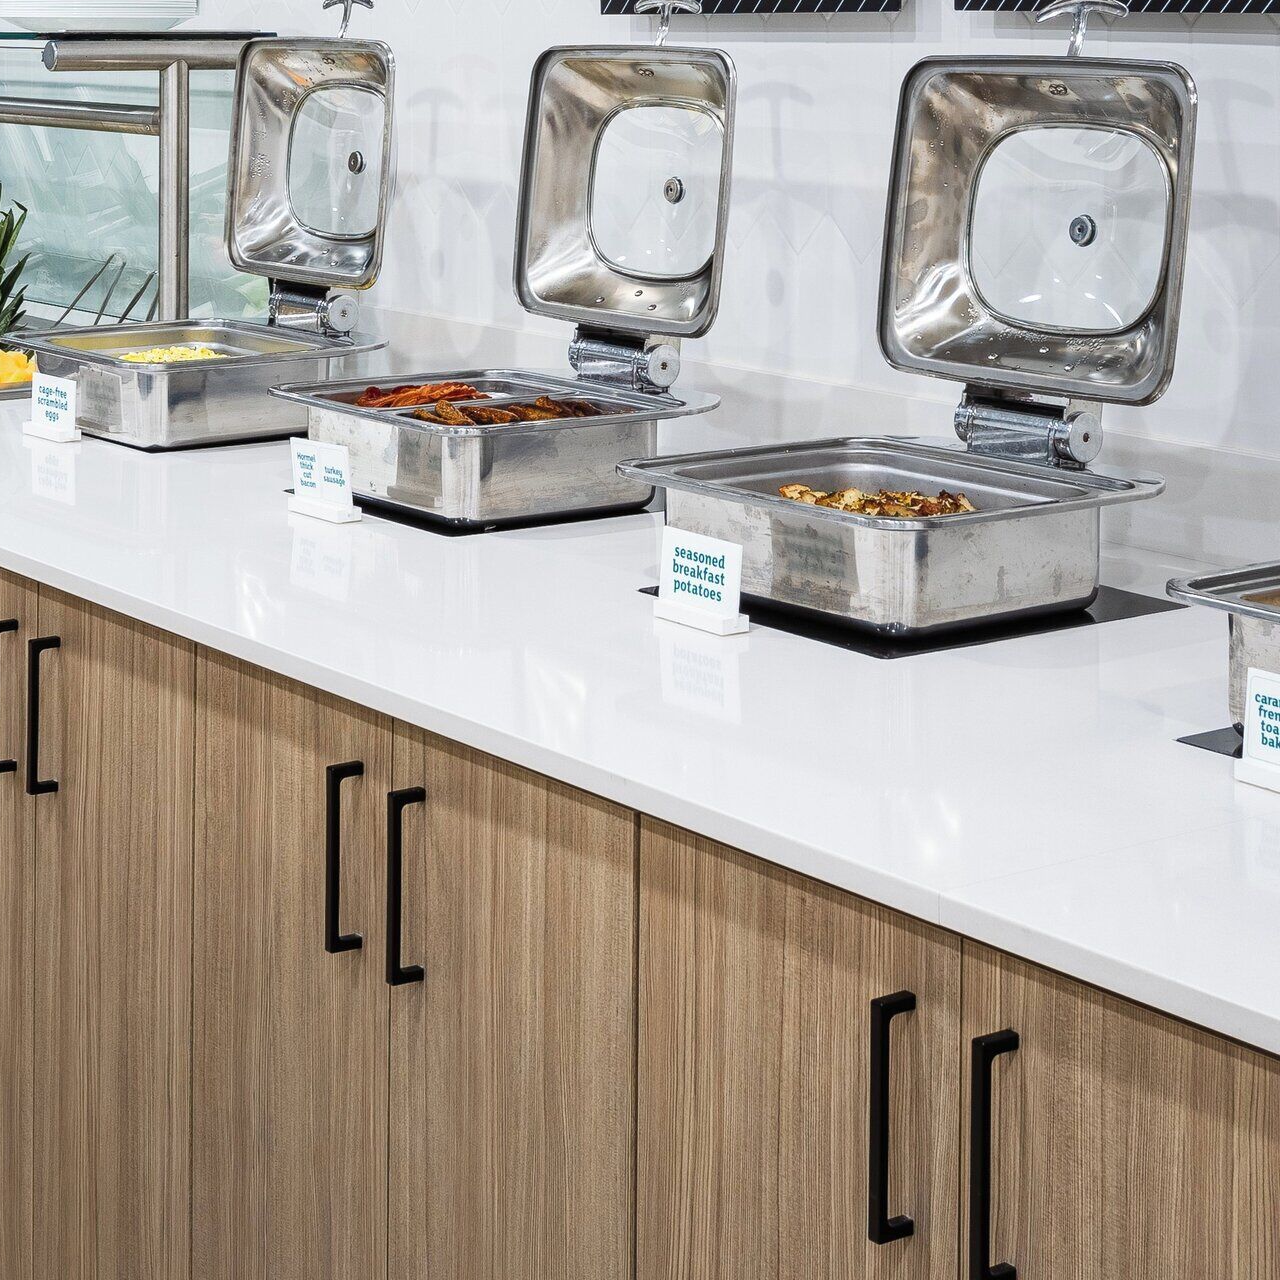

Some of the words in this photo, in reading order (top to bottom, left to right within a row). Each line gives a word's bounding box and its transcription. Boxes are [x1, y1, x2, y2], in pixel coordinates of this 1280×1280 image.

[39, 386, 67, 399] cage-free
[38, 397, 68, 411] scrambled
[45, 410, 59, 422] eggs
[325, 466, 342, 478] turkey
[300, 479, 317, 488] bacon
[324, 476, 346, 487] sausage
[674, 546, 725, 569] seasoned
[672, 559, 725, 586] breakfast
[674, 579, 722, 602] potatoes
